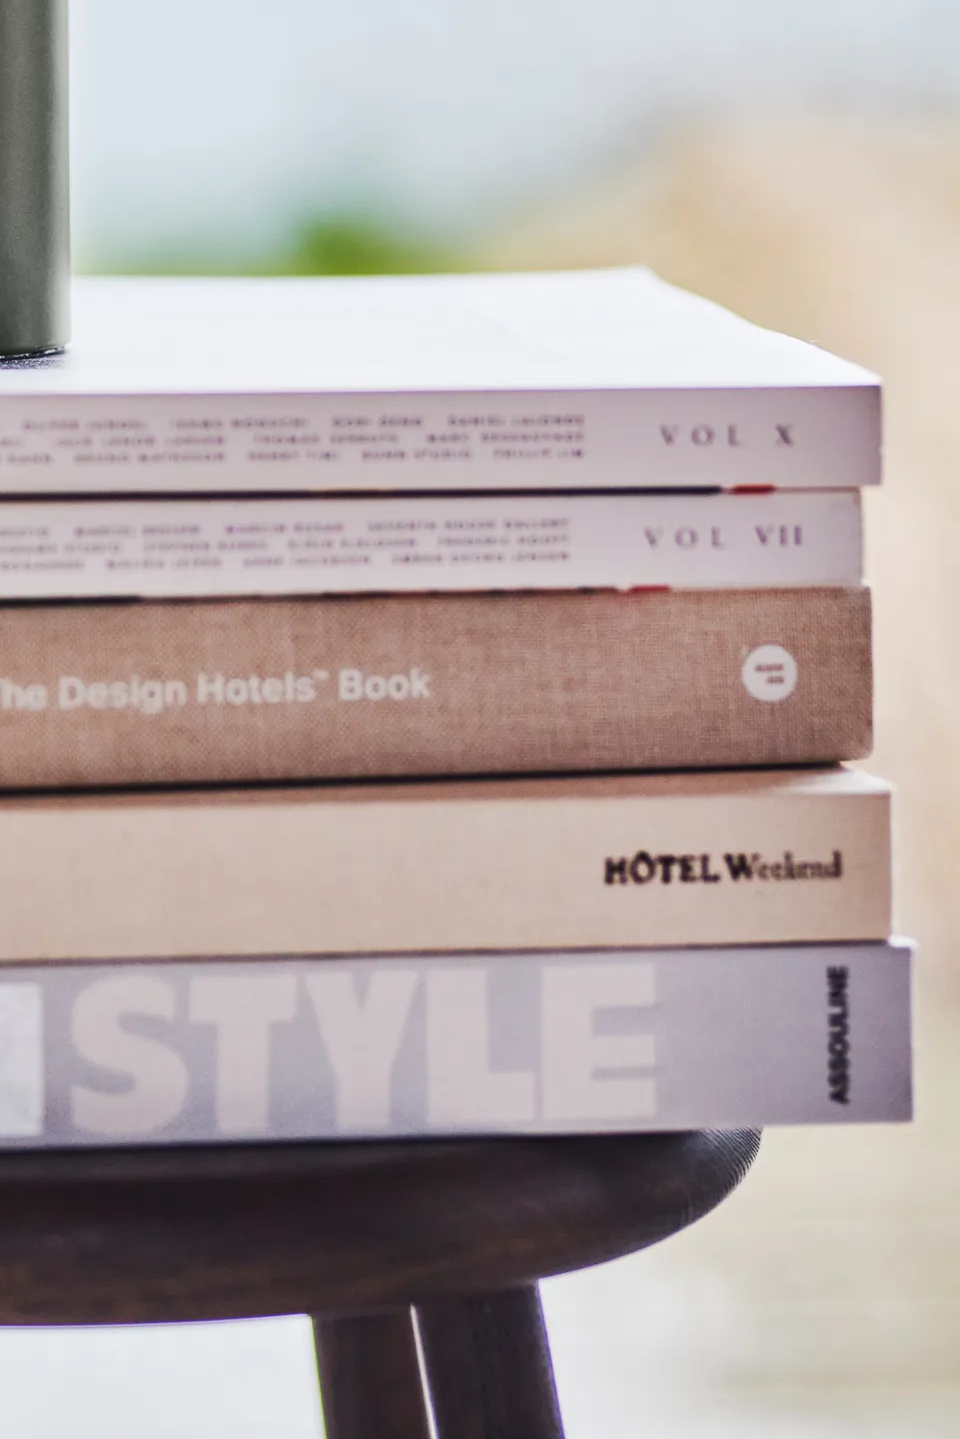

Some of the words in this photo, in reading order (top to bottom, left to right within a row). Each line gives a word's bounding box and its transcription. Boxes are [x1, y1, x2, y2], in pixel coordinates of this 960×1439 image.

[659, 422, 741, 448] VOL
[775, 422, 794, 448] X
[643, 525, 725, 551] VOL
[754, 524, 803, 548] VII
[57, 673, 188, 715] Design
[338, 667, 432, 702] Book
[70, 963, 659, 1138] STYLE
